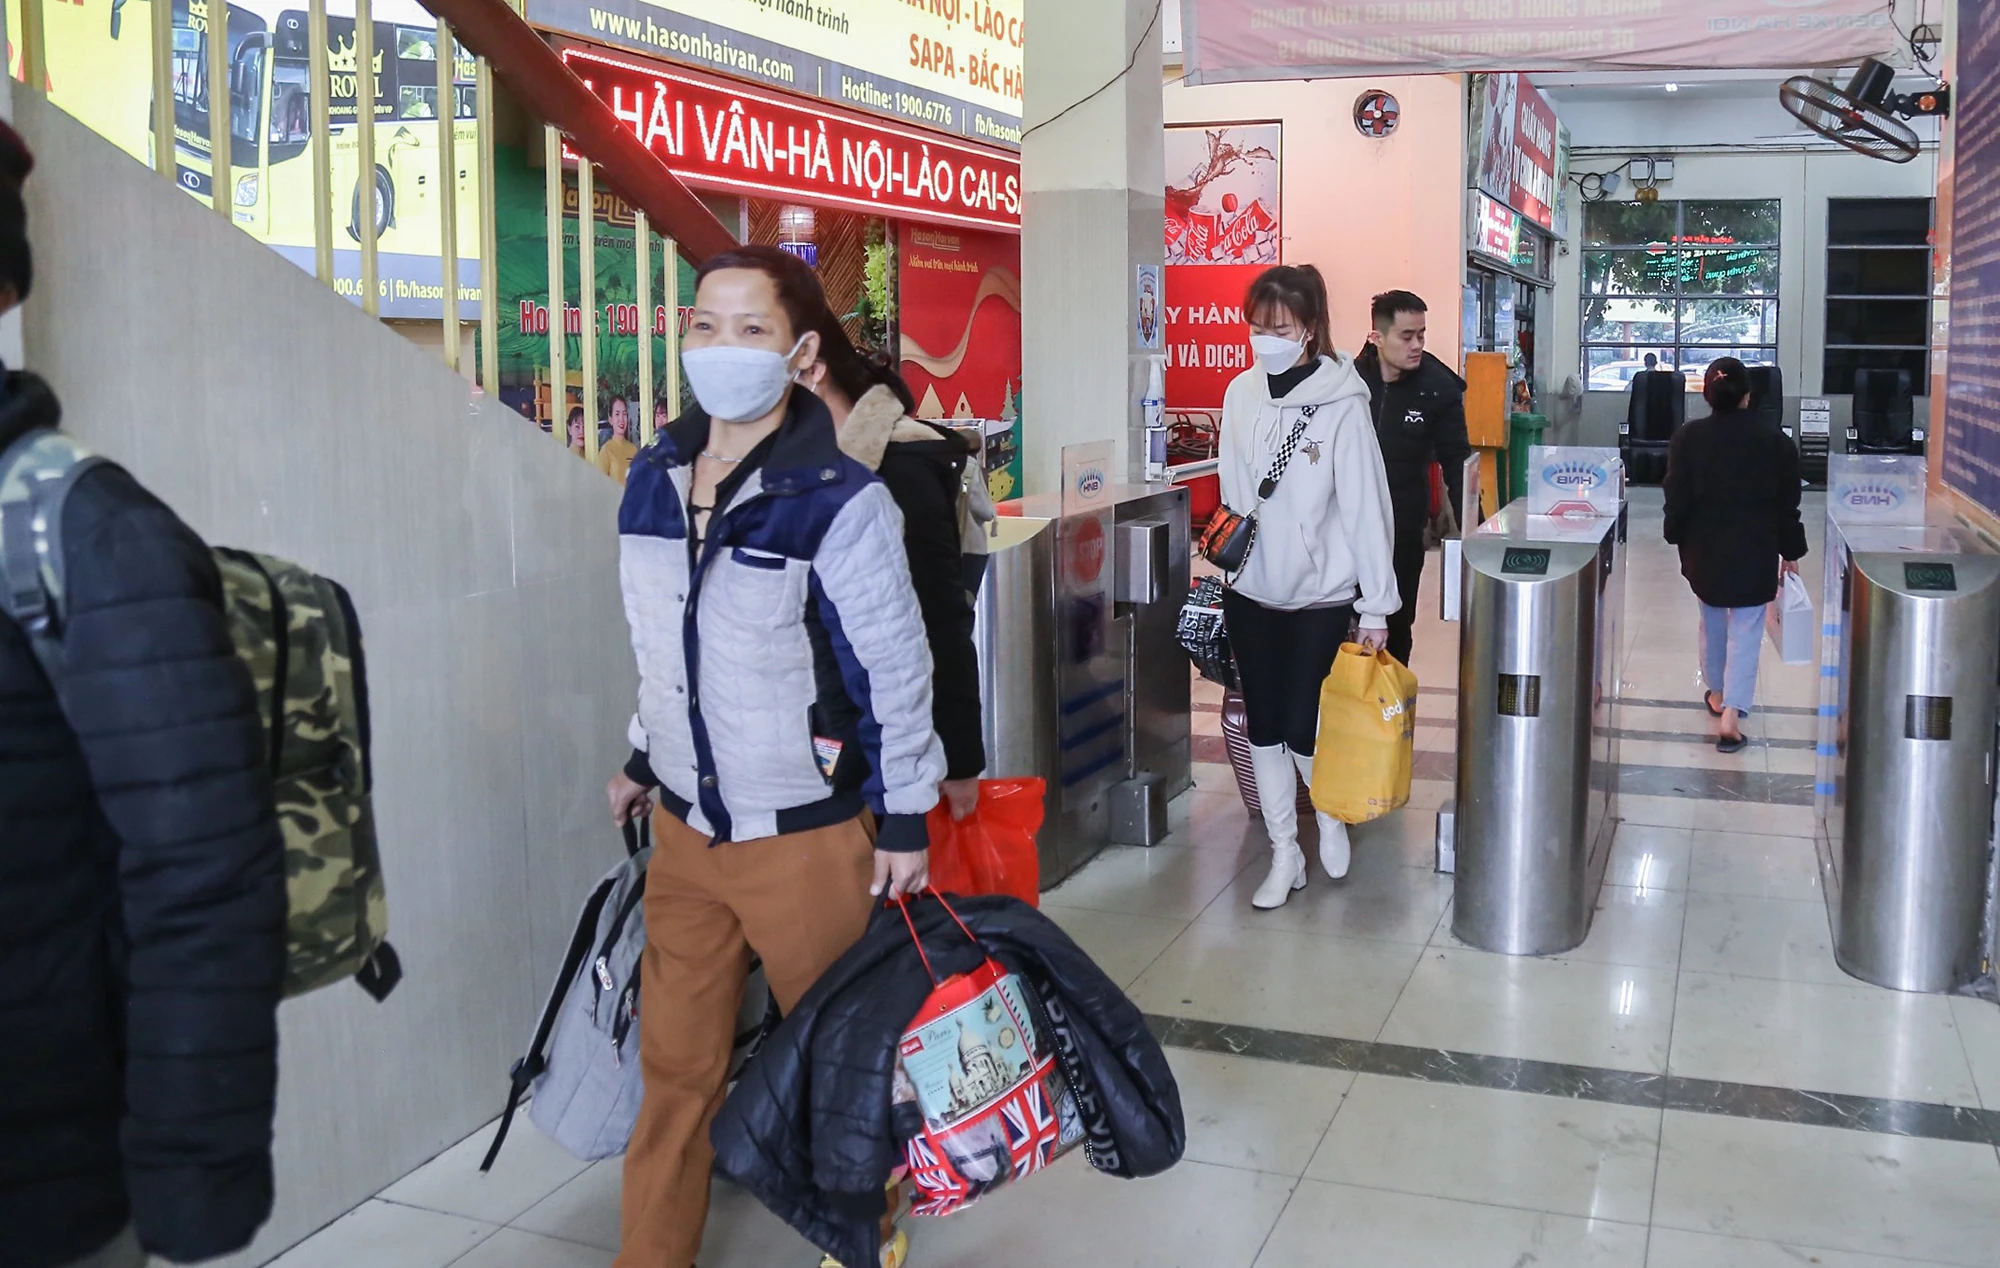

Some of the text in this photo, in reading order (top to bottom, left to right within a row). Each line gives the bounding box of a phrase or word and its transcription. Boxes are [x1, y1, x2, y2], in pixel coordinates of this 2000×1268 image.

[817, 6, 849, 34] trình
[1008, 17, 1024, 48] CA
[589, 7, 794, 83] www.hasonhaivan.com
[909, 33, 955, 79] SAPA
[969, 48, 1000, 94] BẮC
[1003, 64, 1024, 101] HÀ
[842, 75, 893, 110] Hotline:
[894, 91, 953, 126] 1900.6776
[613, 80, 683, 156] HẢI
[959, 165, 1022, 215] CAI-S
[1177, 339, 1200, 368] VÀ
[1205, 344, 1246, 373] DỊCH
[1083, 481, 1099, 493] HNB
[1382, 699, 1402, 722] yod
